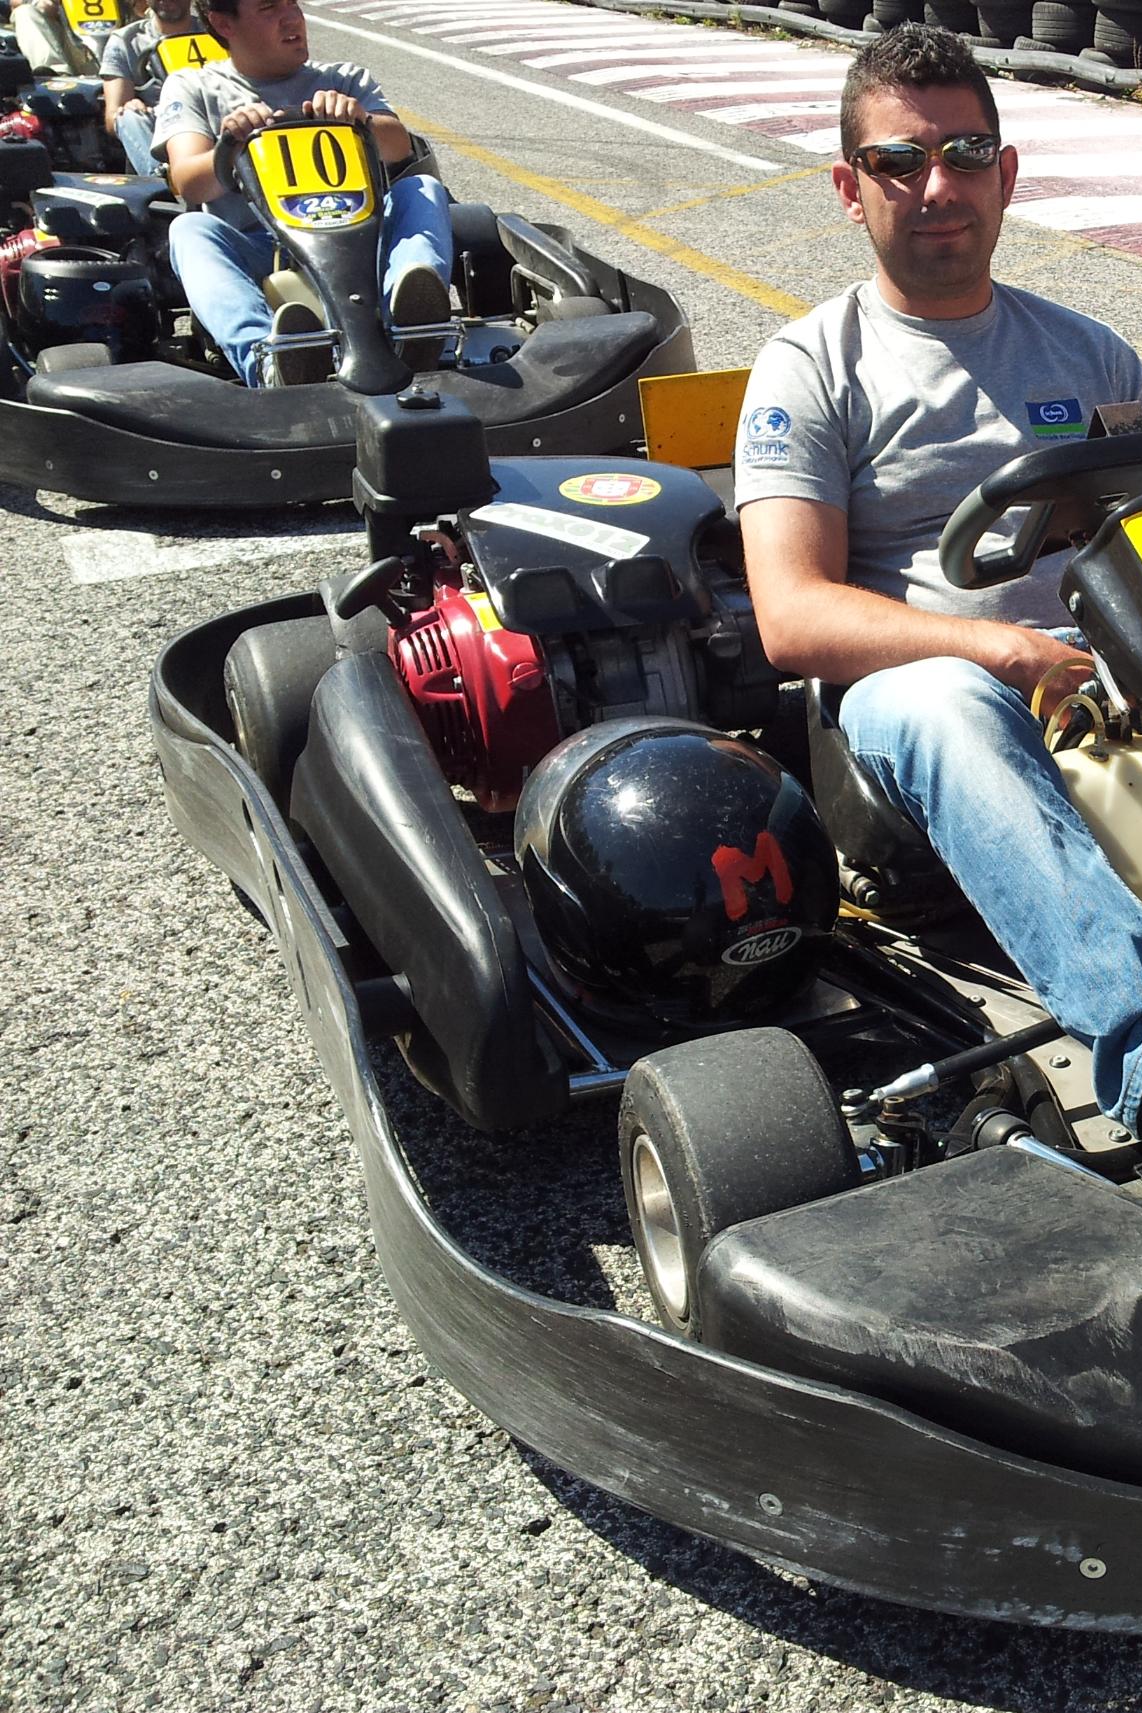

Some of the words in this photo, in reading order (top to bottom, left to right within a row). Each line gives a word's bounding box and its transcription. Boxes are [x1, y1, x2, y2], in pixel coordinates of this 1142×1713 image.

[84, 0, 104, 16] 8
[187, 38, 207, 70] 4
[277, 129, 348, 188] 10
[303, 196, 337, 213] 24
[711, 831, 794, 921] M
